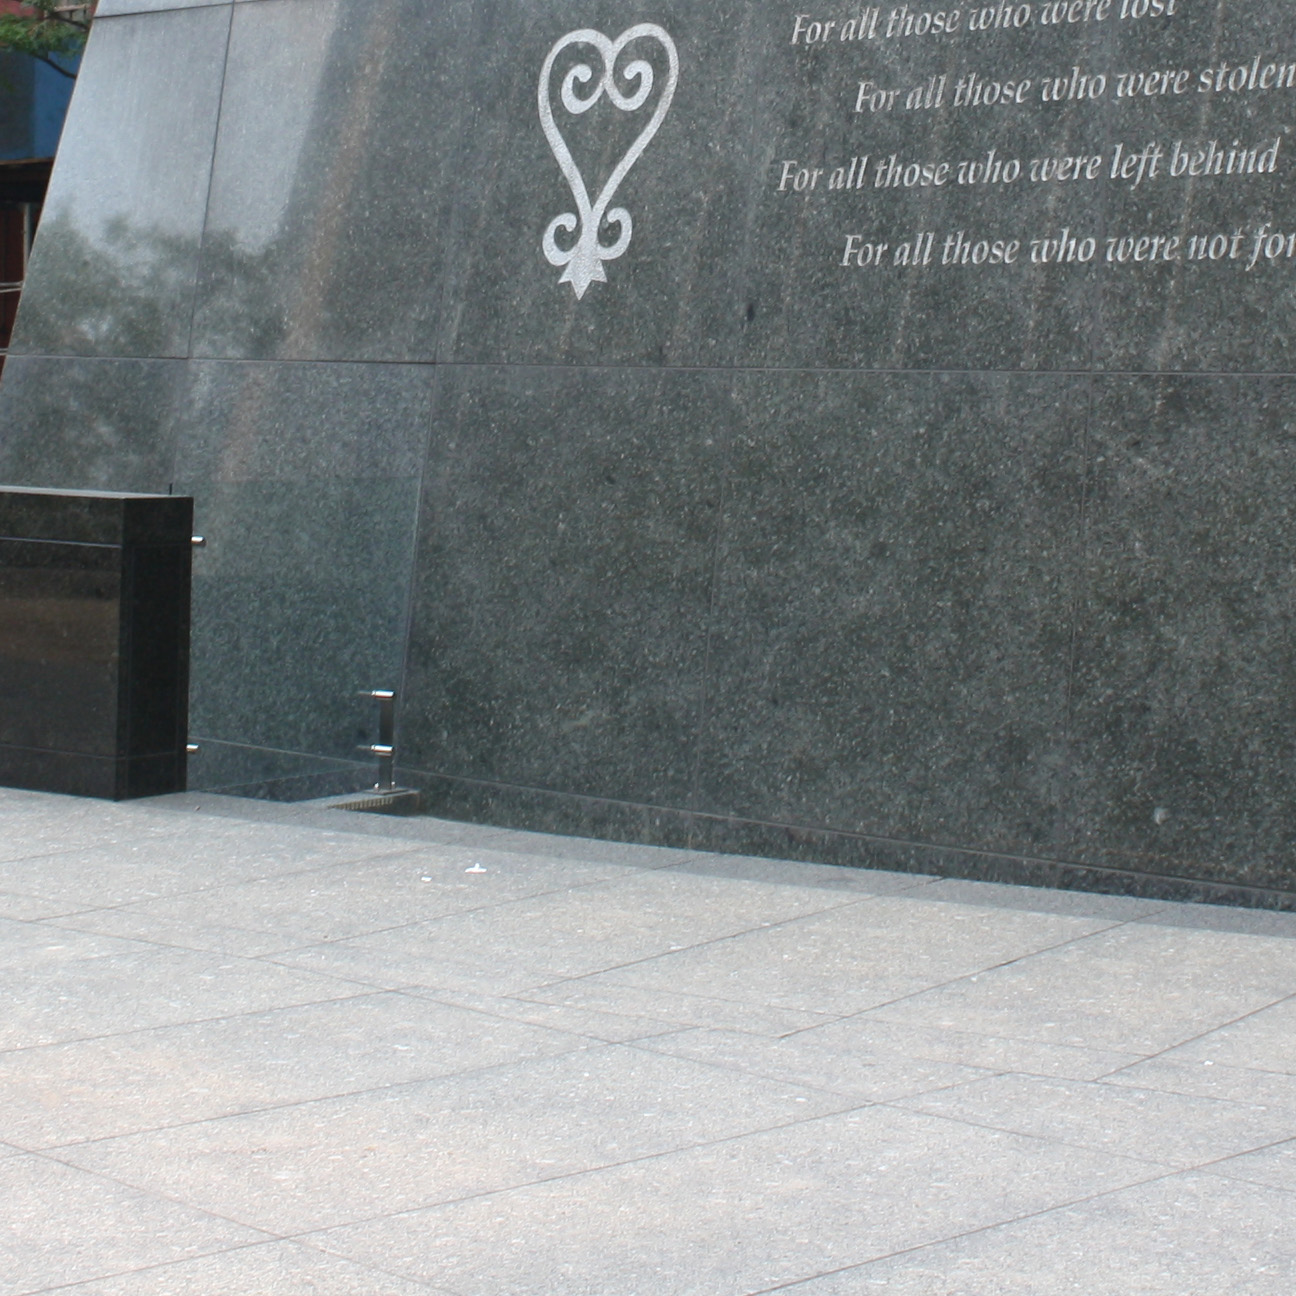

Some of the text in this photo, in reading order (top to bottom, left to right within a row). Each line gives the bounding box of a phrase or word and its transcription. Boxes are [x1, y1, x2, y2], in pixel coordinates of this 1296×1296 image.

[789, 14, 835, 45] For
[840, 6, 880, 41] all
[886, 4, 961, 38] those
[854, 80, 900, 113] For
[906, 74, 948, 110] all
[954, 72, 1031, 107] those
[1041, 66, 1106, 102] who
[1116, 69, 1190, 97] were
[776, 136, 1281, 191] For all those who were left behind
[840, 234, 889, 266] For
[893, 231, 935, 266] all
[941, 230, 1020, 265] those
[1030, 227, 1096, 264] who
[1105, 235, 1180, 262] were
[1187, 228, 1244, 260] not
